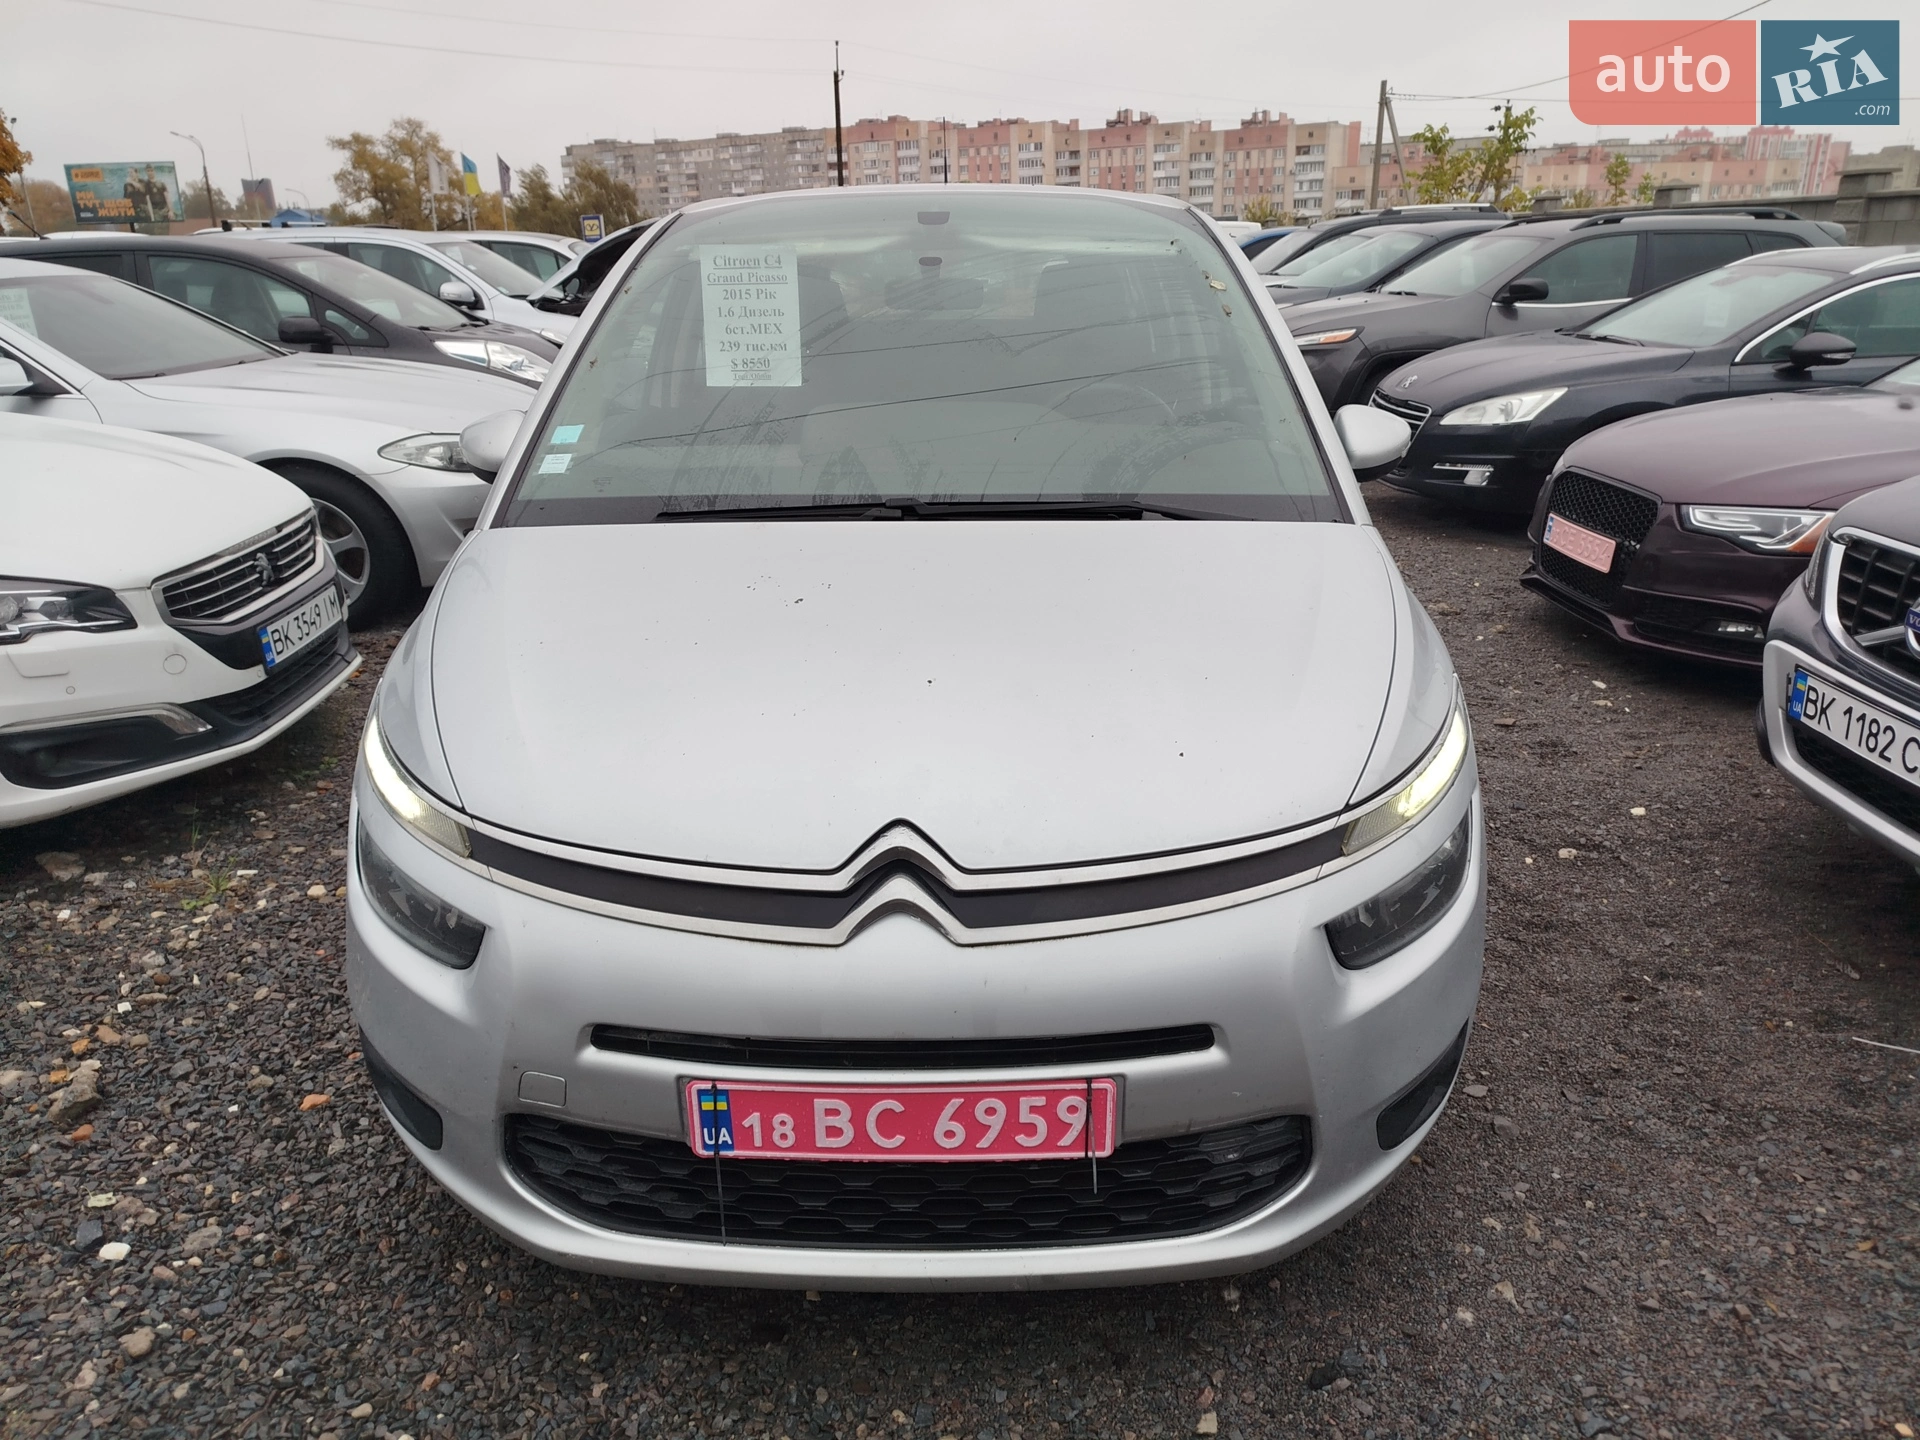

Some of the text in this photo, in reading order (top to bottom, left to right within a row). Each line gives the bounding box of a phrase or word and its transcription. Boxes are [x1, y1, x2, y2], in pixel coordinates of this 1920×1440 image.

[76, 191, 95, 200] МИ
[77, 199, 101, 209] ТУТ
[98, 207, 136, 217] ЖИТИ
[713, 254, 782, 267] Citroen C4
[707, 271, 788, 283] Grand Picasso
[723, 288, 777, 300] 2015 Рік
[718, 306, 785, 318] 1.6 Дизель
[720, 340, 787, 352] 239 тис.км
[731, 358, 770, 369] $ 8550
[271, 620, 295, 656] BK
[293, 603, 322, 642] 3549
[1792, 701, 1802, 714] UA
[1803, 685, 1836, 732] BK
[1843, 705, 1896, 764] 1182
[704, 1095, 1089, 1149] UA 18 BC 6959
